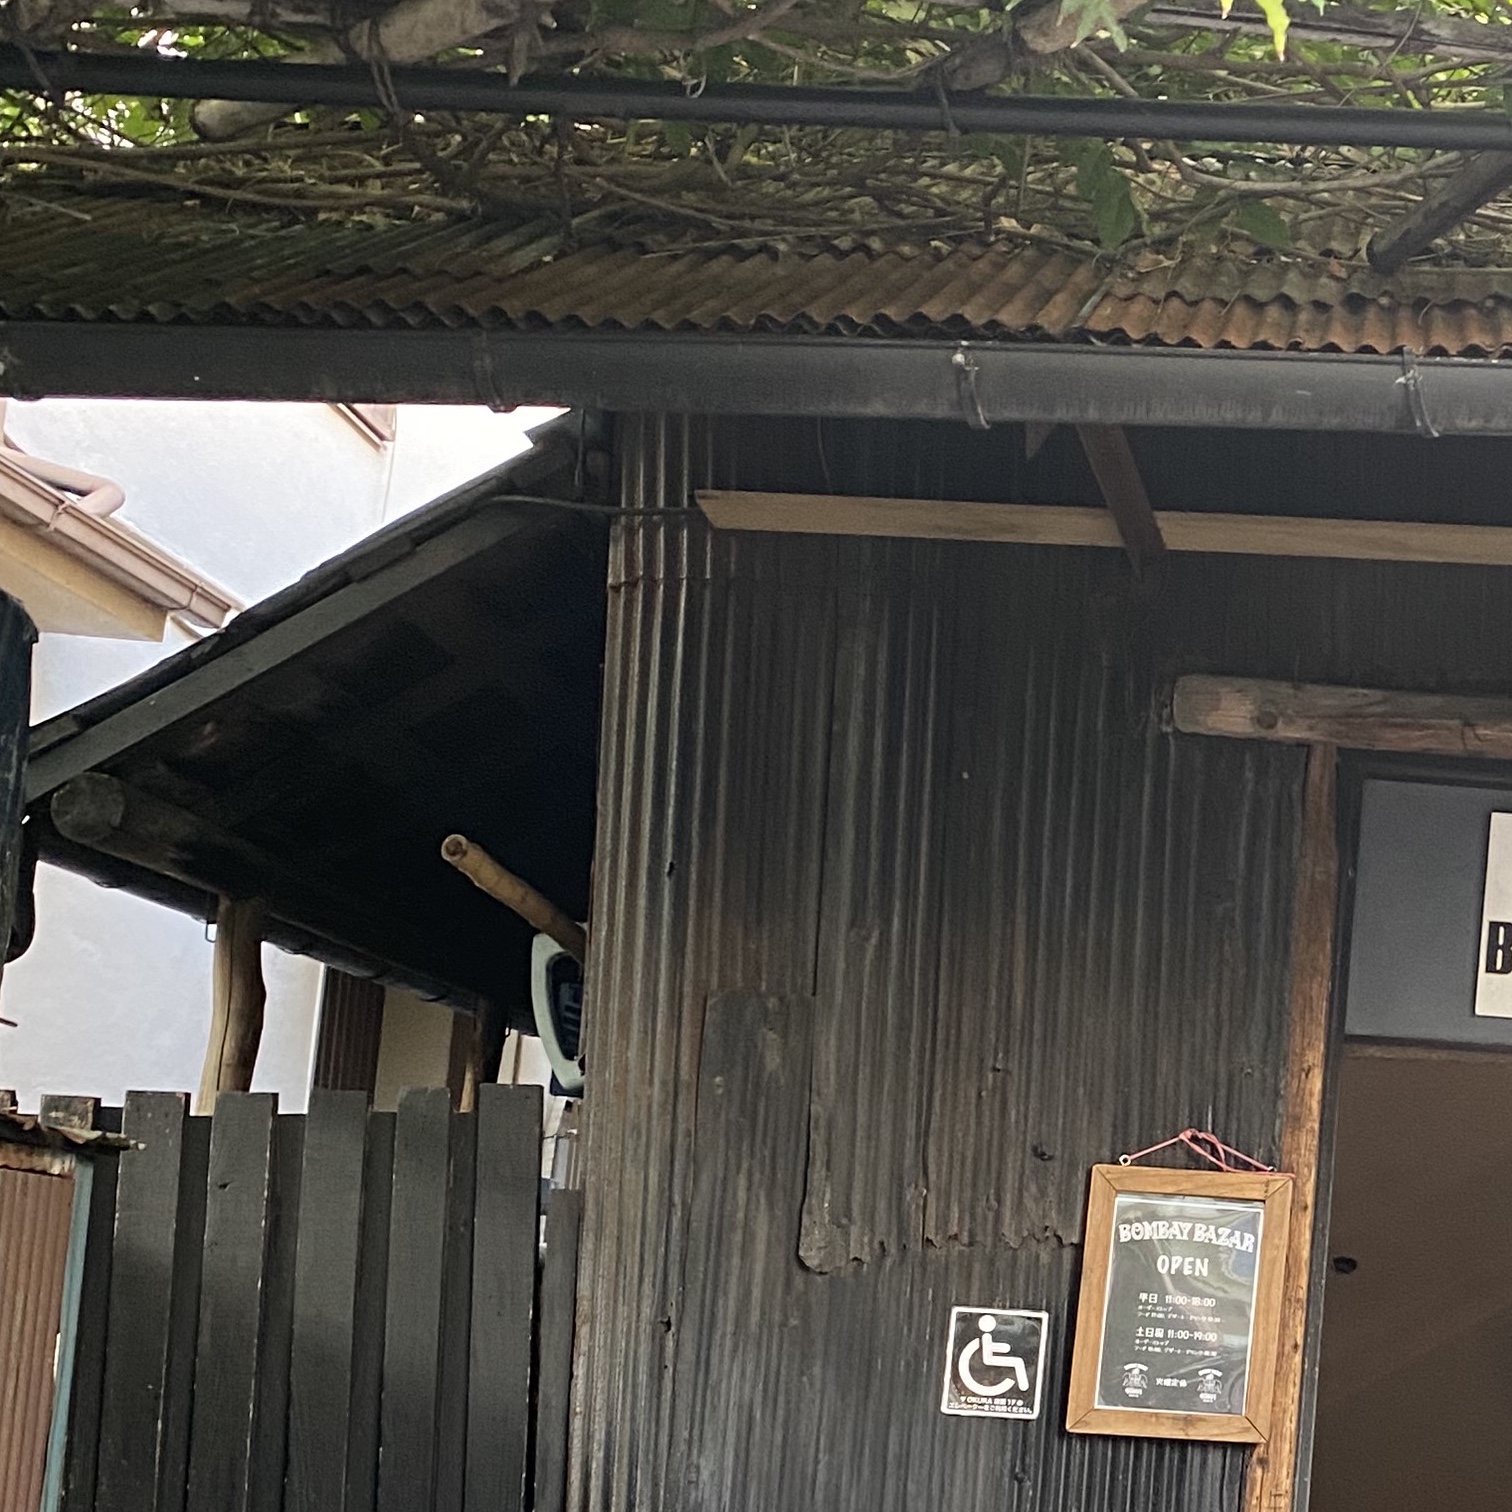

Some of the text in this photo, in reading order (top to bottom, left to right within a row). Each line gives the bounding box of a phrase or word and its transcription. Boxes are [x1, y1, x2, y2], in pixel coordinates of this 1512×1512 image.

[1118, 1220, 1255, 1253] BOMBAY BAZAR
[1156, 1254, 1209, 1277] OPEN
[1138, 1292, 1158, 1304] 平日
